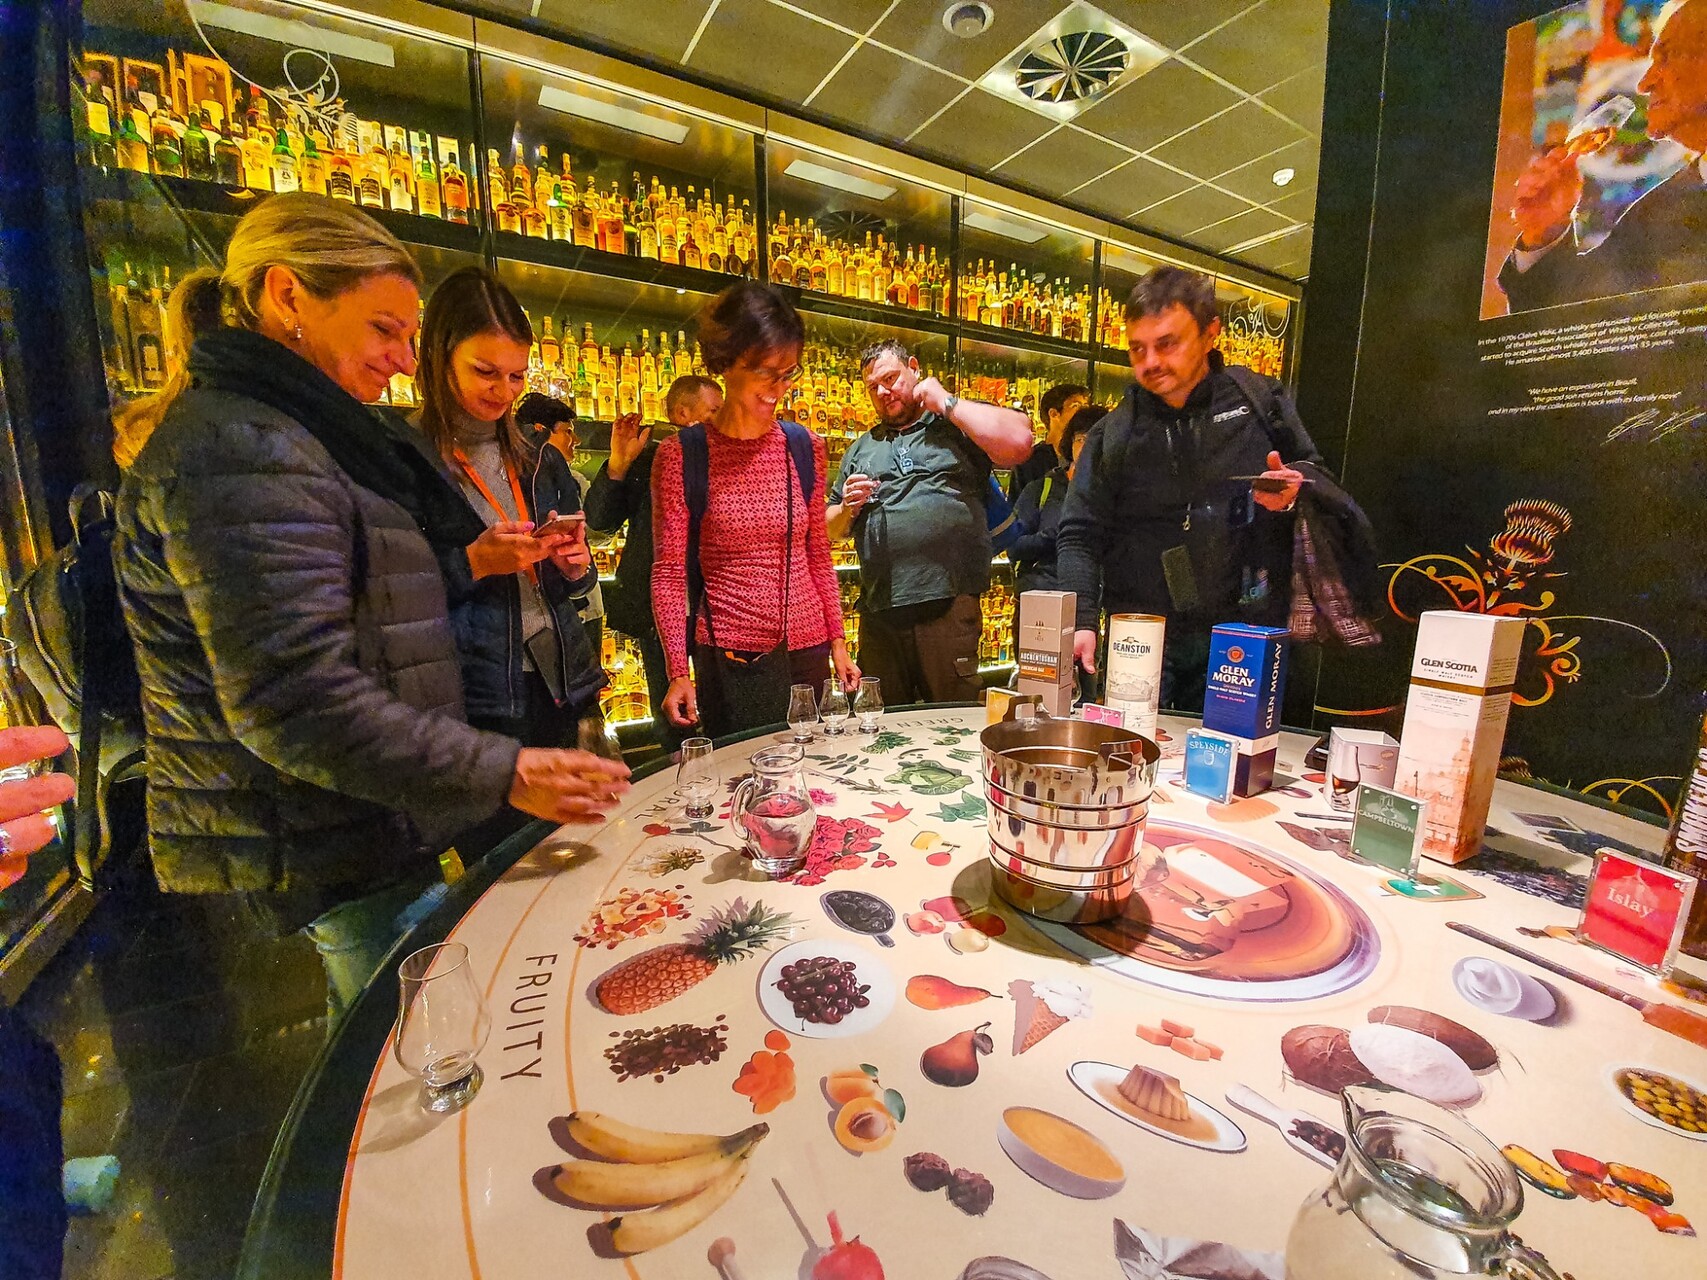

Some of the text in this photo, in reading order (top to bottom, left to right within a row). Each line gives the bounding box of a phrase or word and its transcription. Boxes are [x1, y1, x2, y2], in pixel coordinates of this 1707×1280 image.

[1113, 642, 1151, 654] DEANSTON
[1220, 664, 1249, 677] GLEN
[1420, 657, 1444, 669] GLEN
[1445, 660, 1478, 674] SCOTIA
[1212, 672, 1256, 688] MORAY
[1265, 642, 1282, 730] GLEN MORAY
[898, 717, 964, 729] GREEN
[1189, 740, 1230, 756] SPEYSIDE
[1358, 810, 1414, 834] CAMPBELTOWN
[1607, 886, 1654, 919] Islay
[500, 954, 558, 1080] FRUITY
